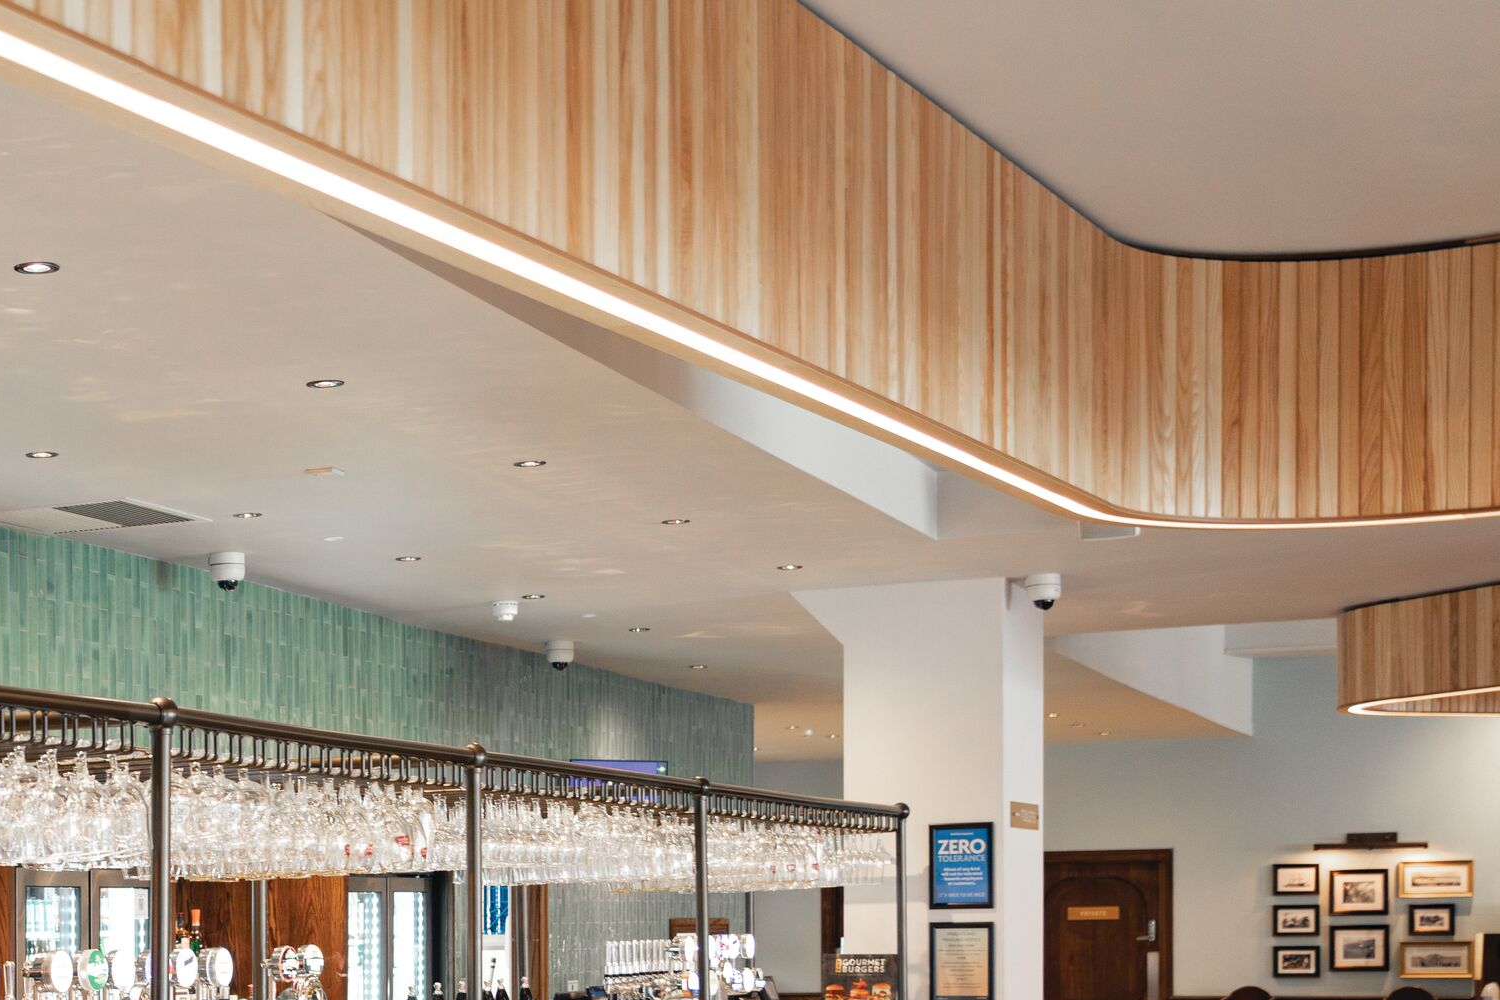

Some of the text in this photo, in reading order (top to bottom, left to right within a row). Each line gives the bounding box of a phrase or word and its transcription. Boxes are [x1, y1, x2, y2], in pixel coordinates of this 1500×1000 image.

[937, 838, 986, 855] ZERO
[937, 854, 985, 863] TOLERANCE
[842, 958, 886, 966] GOURMET
[842, 965, 885, 973] BURGERS
